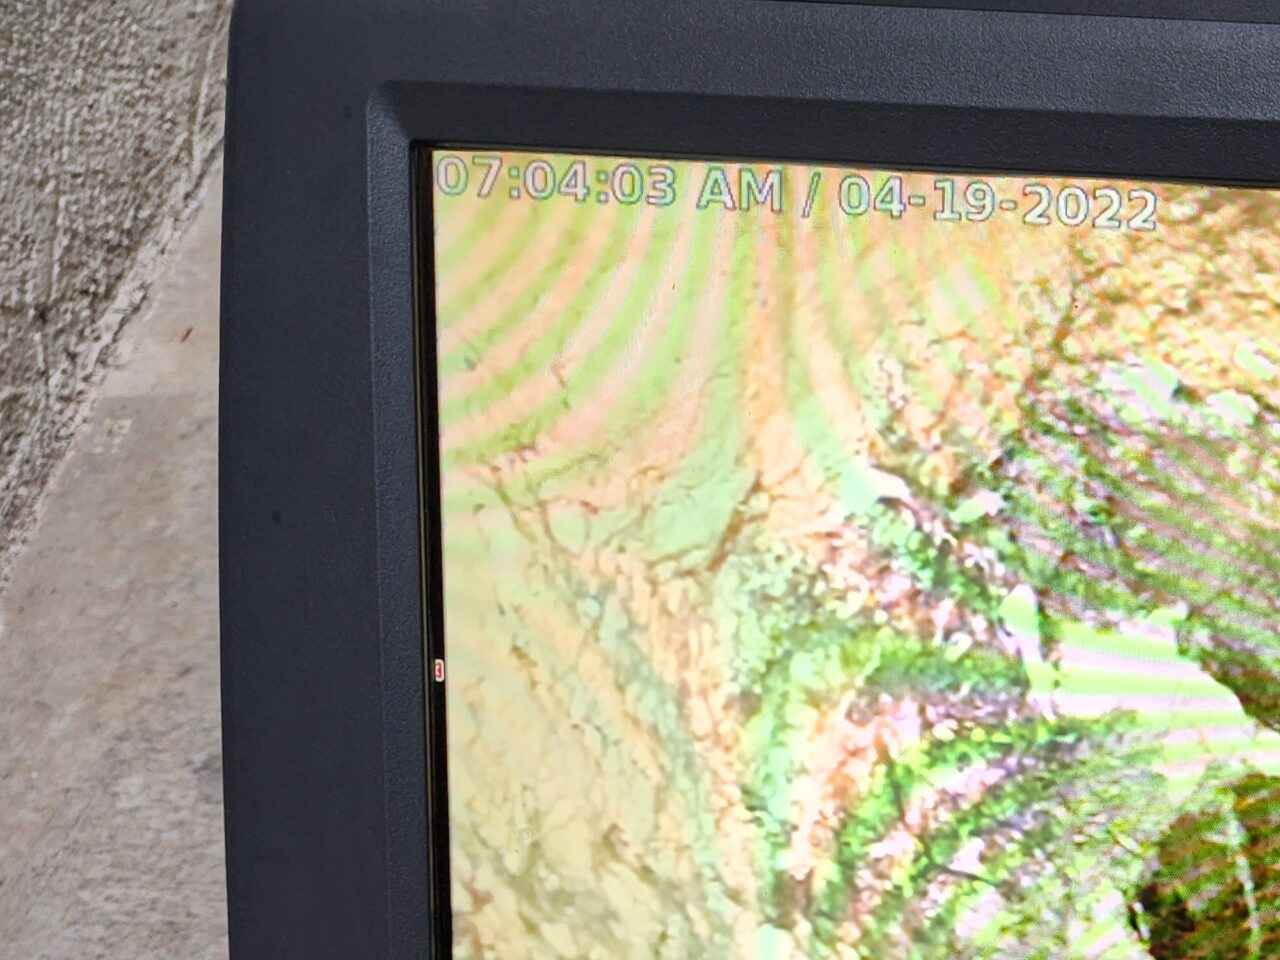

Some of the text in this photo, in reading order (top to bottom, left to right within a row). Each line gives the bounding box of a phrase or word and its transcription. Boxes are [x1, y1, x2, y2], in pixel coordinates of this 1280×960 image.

[436, 156, 1158, 230] 07:04:03 AM / 04-19-2022
